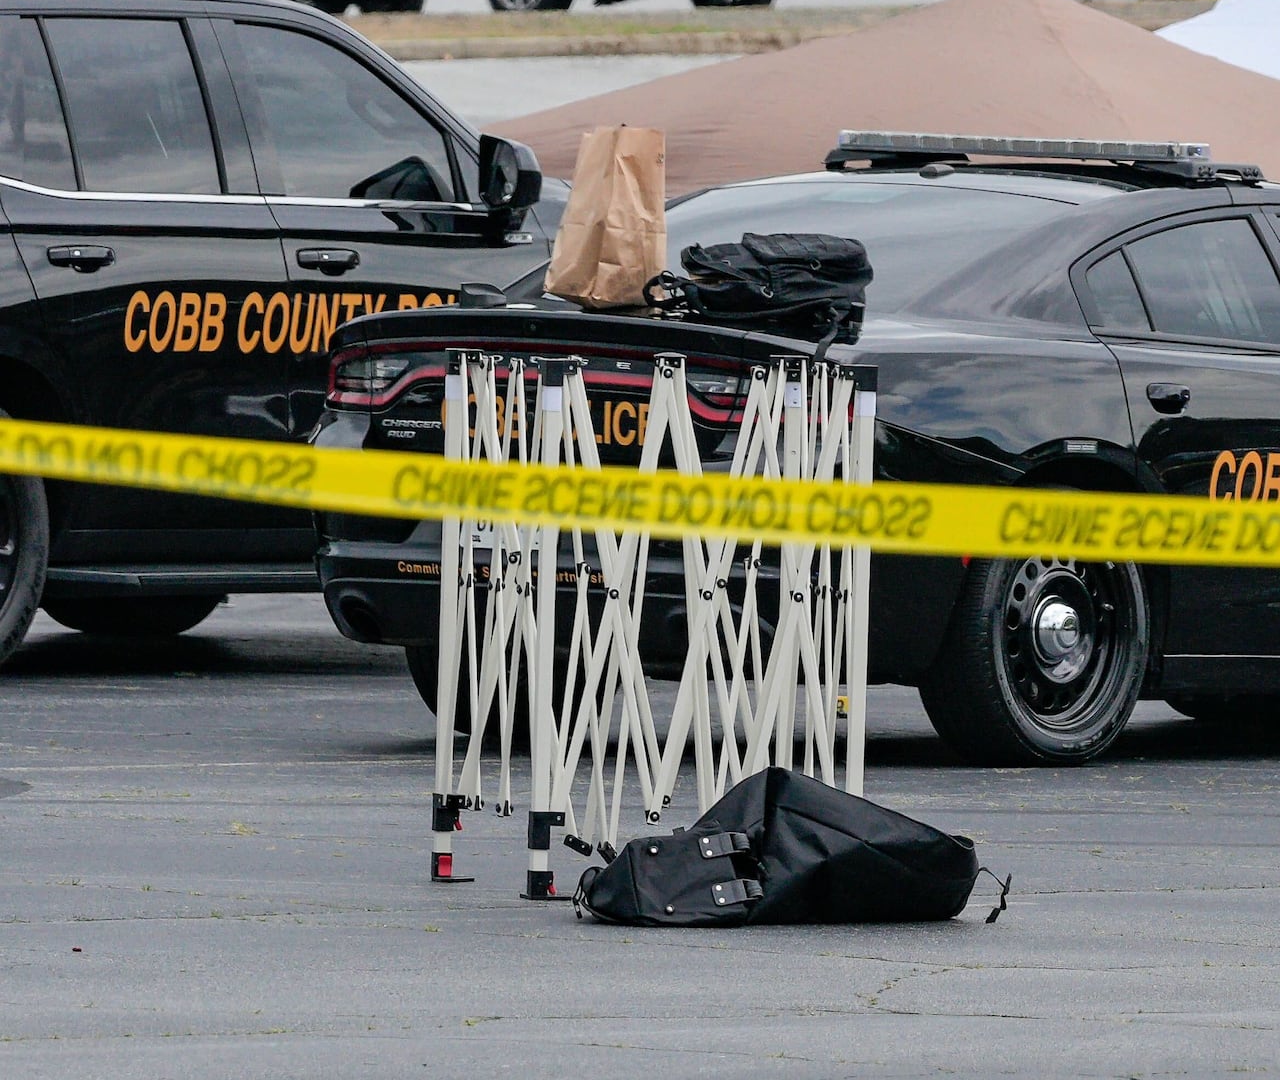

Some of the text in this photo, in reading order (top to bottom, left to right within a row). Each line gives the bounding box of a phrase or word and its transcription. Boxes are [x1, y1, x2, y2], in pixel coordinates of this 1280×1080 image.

[124, 290, 227, 353] COBB
[382, 418, 442, 430] CHARGER
[387, 430, 417, 439] AWD
